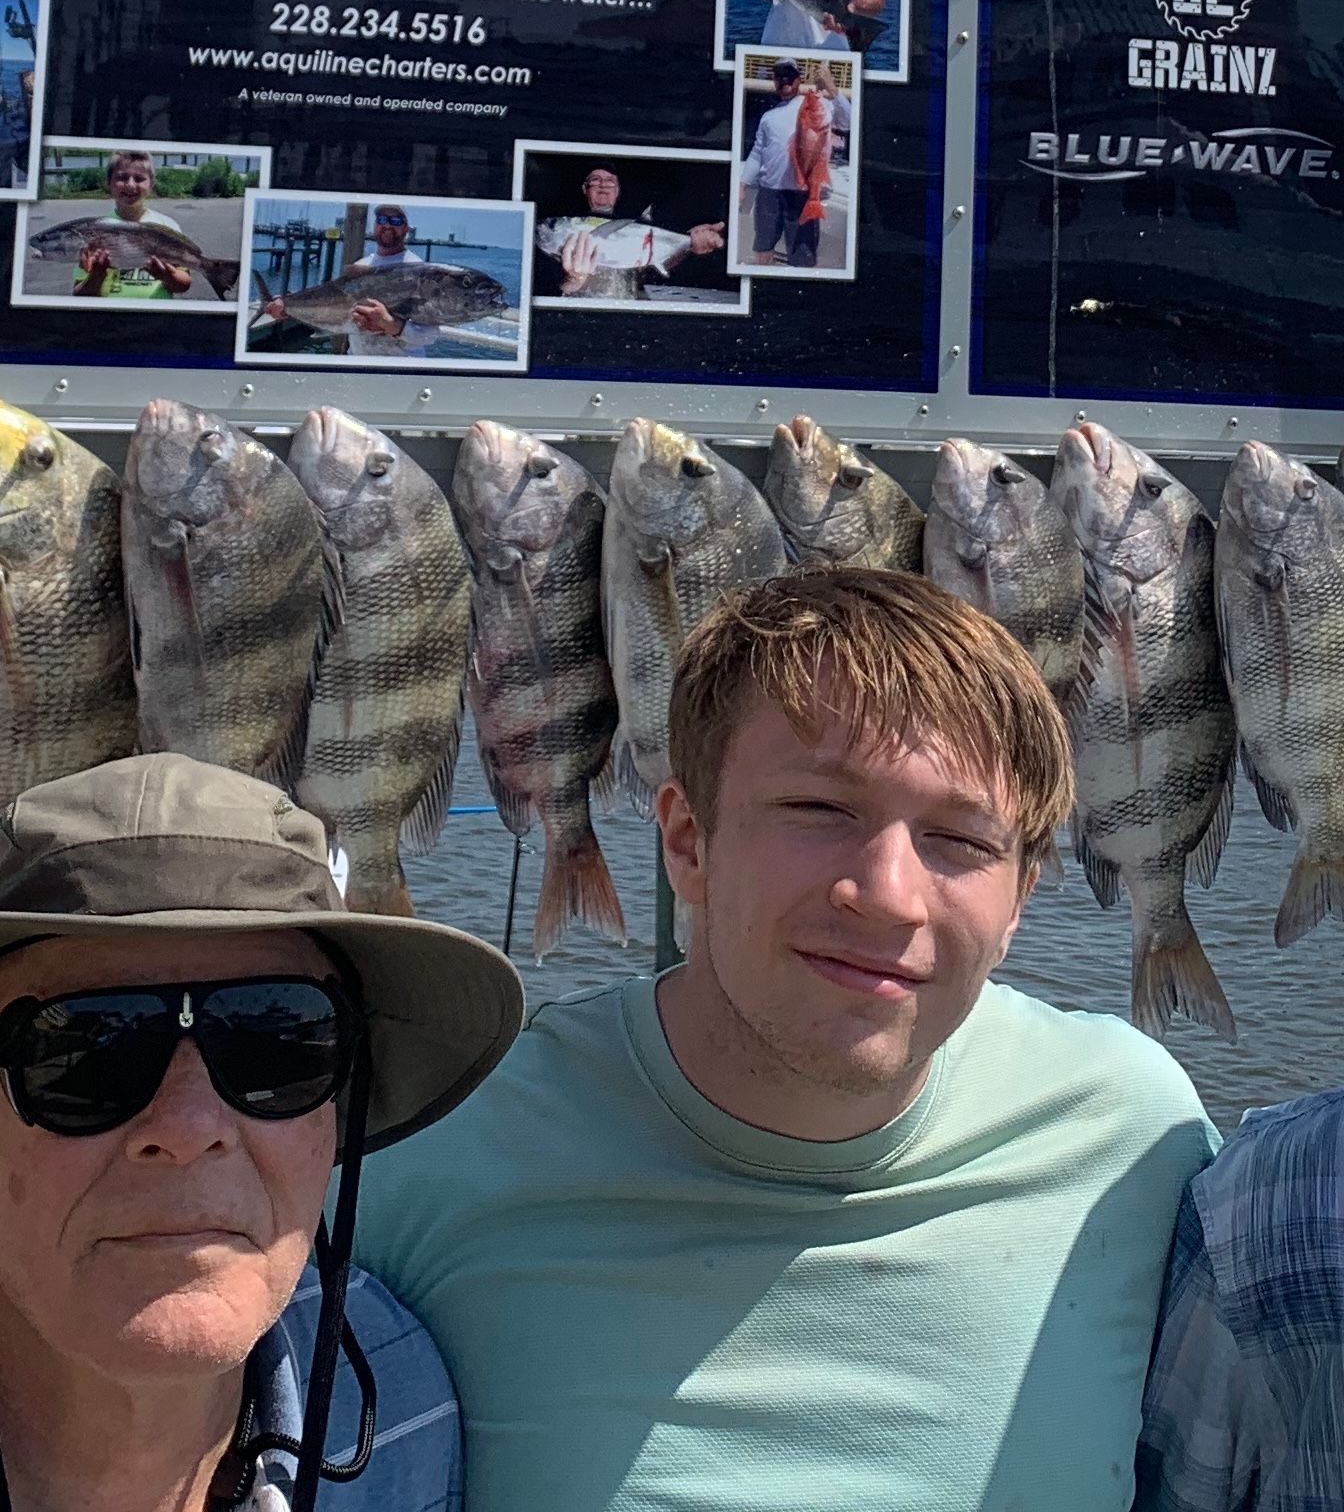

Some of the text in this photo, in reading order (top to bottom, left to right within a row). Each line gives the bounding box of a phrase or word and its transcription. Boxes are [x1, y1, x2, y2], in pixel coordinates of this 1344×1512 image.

[268, 1, 487, 46] 228.234.5516
[188, 45, 532, 85] www.aquilinecharters.com
[1127, 37, 1277, 97] GRAINZ
[237, 88, 508, 117] A veteran owned and operated company
[1027, 131, 1334, 180] BLUE WAVE
